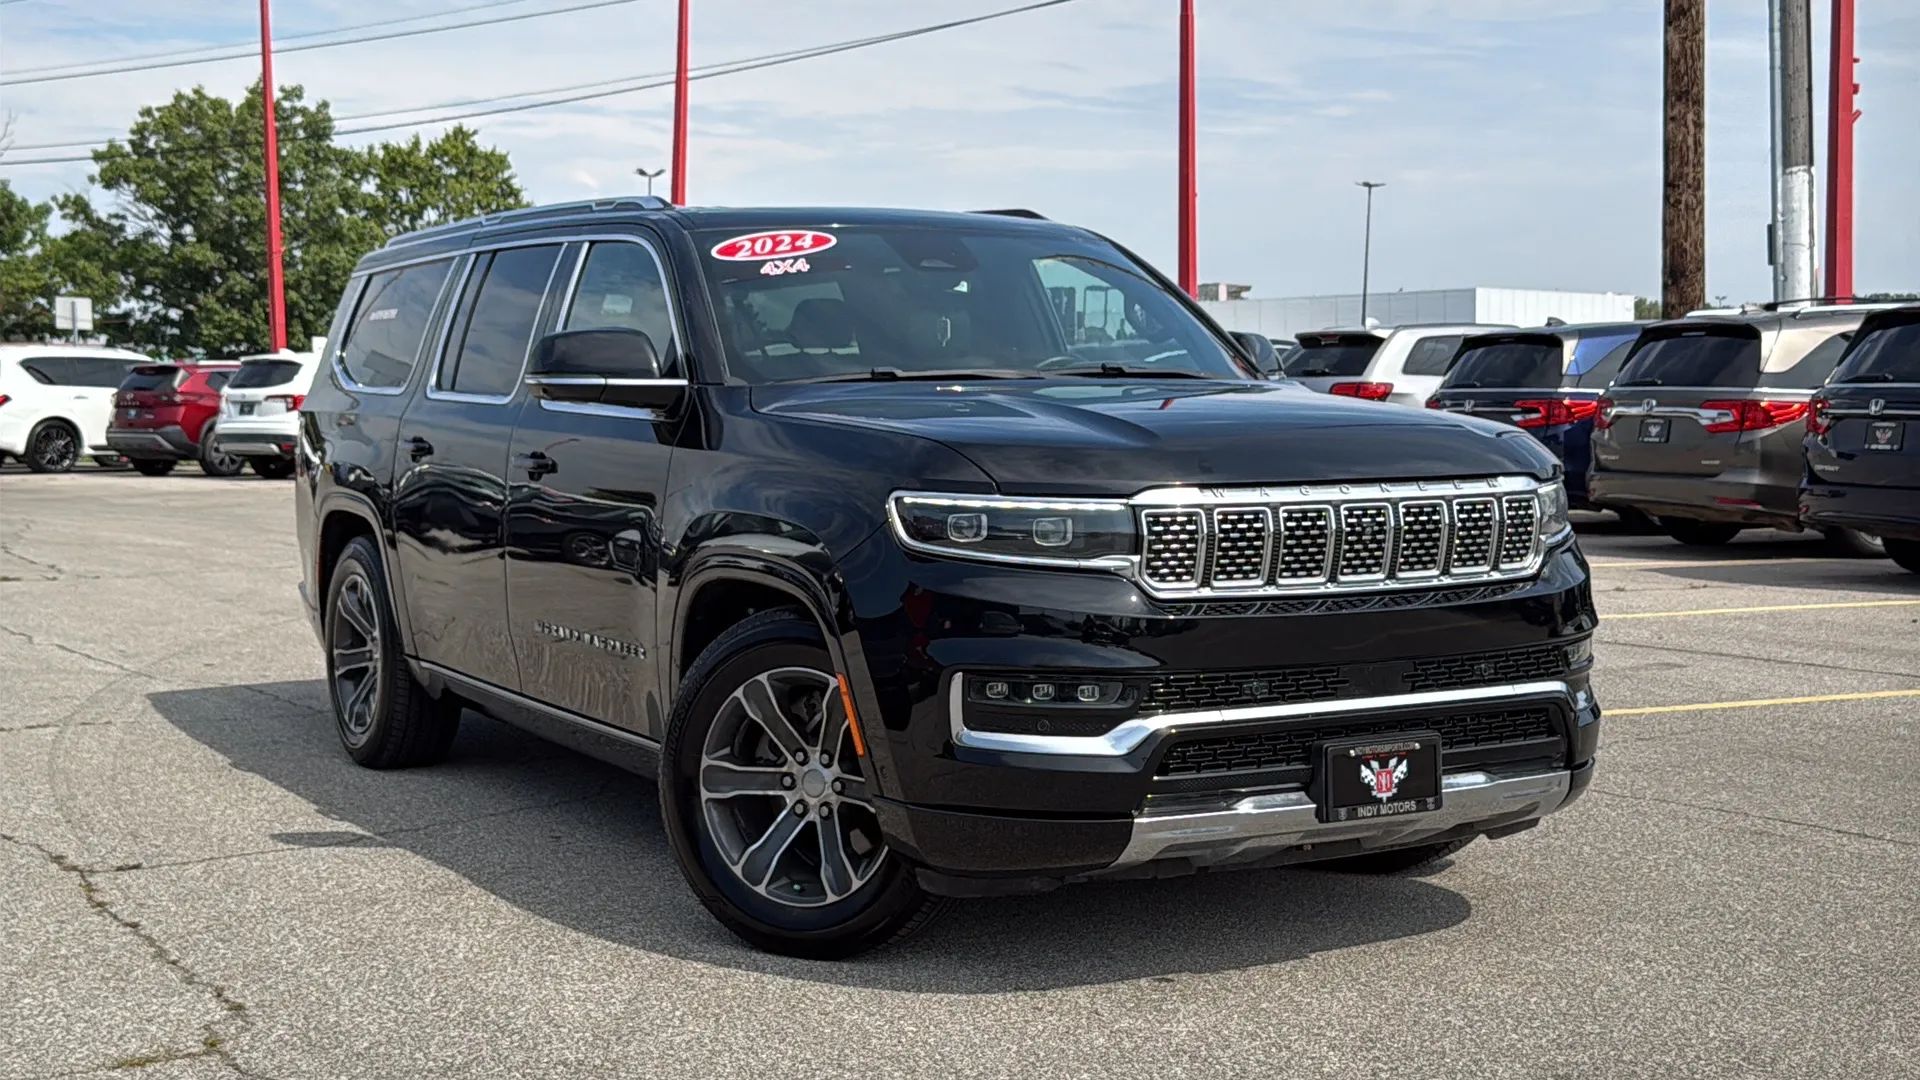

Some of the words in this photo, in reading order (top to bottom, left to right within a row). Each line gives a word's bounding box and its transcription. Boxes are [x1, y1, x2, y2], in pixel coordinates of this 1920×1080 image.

[735, 232, 814, 258] 2024
[1210, 477, 1500, 498] WAGONEER
[584, 632, 647, 660] WAGONEER
[1357, 806, 1378, 818] INDY
[1380, 801, 1417, 815] MOTORS
